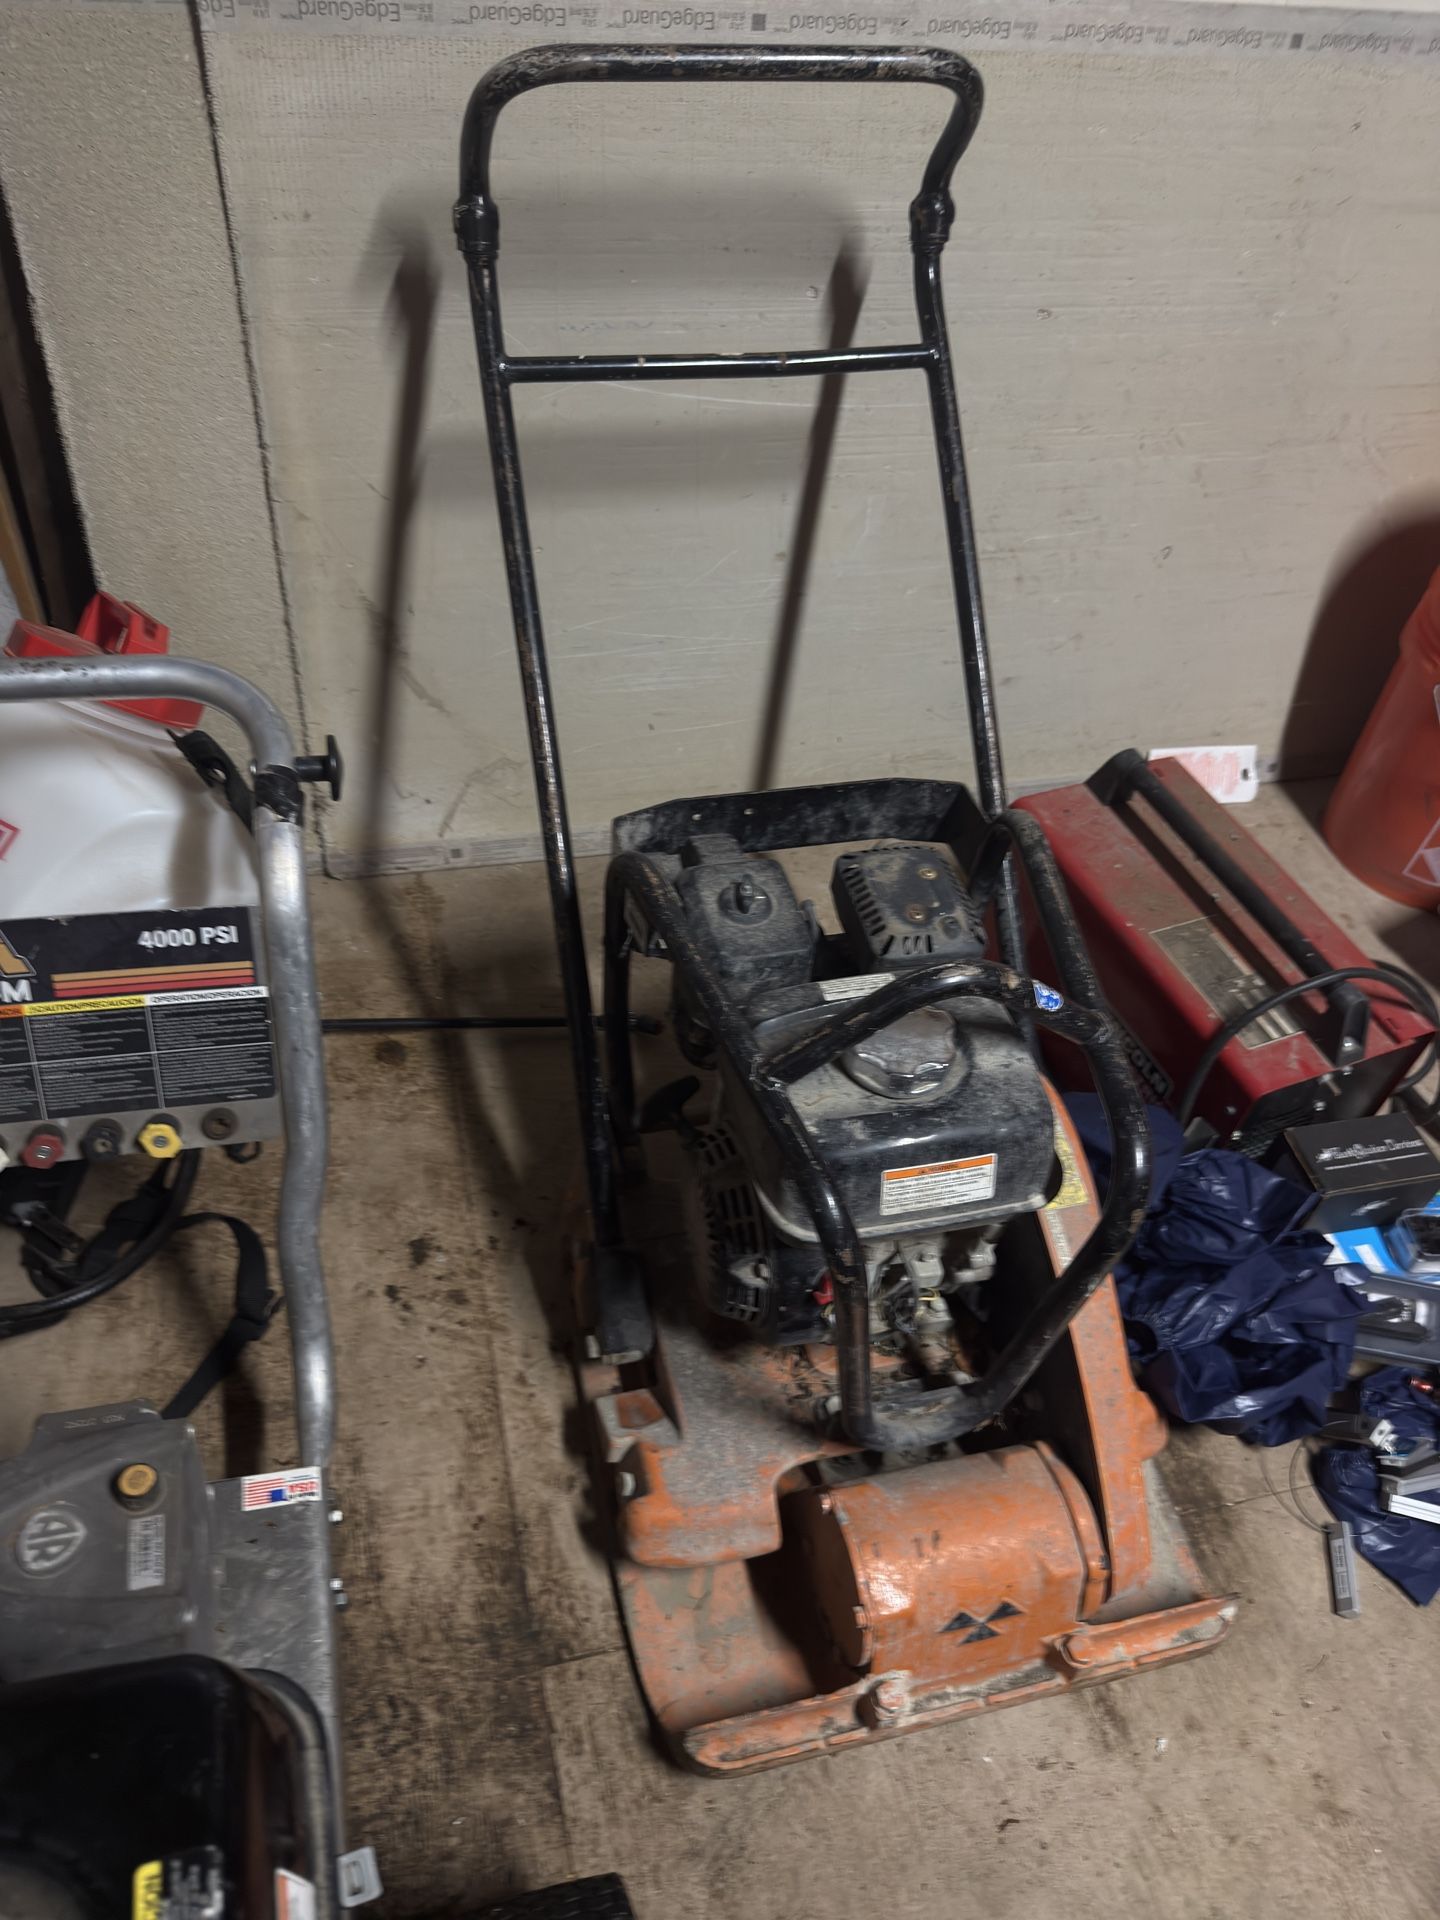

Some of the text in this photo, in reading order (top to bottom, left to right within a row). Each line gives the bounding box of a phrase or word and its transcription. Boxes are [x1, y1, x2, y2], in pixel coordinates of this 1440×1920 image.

[298, 0, 400, 21] EdgeGuard
[469, 4, 566, 27] EdgeGuard
[622, 7, 715, 30] EdgeGuard
[789, 12, 878, 35] EdgeGuard
[926, 16, 1011, 40] EdgeGuard
[137, 925, 239, 949] 4000 PSI
